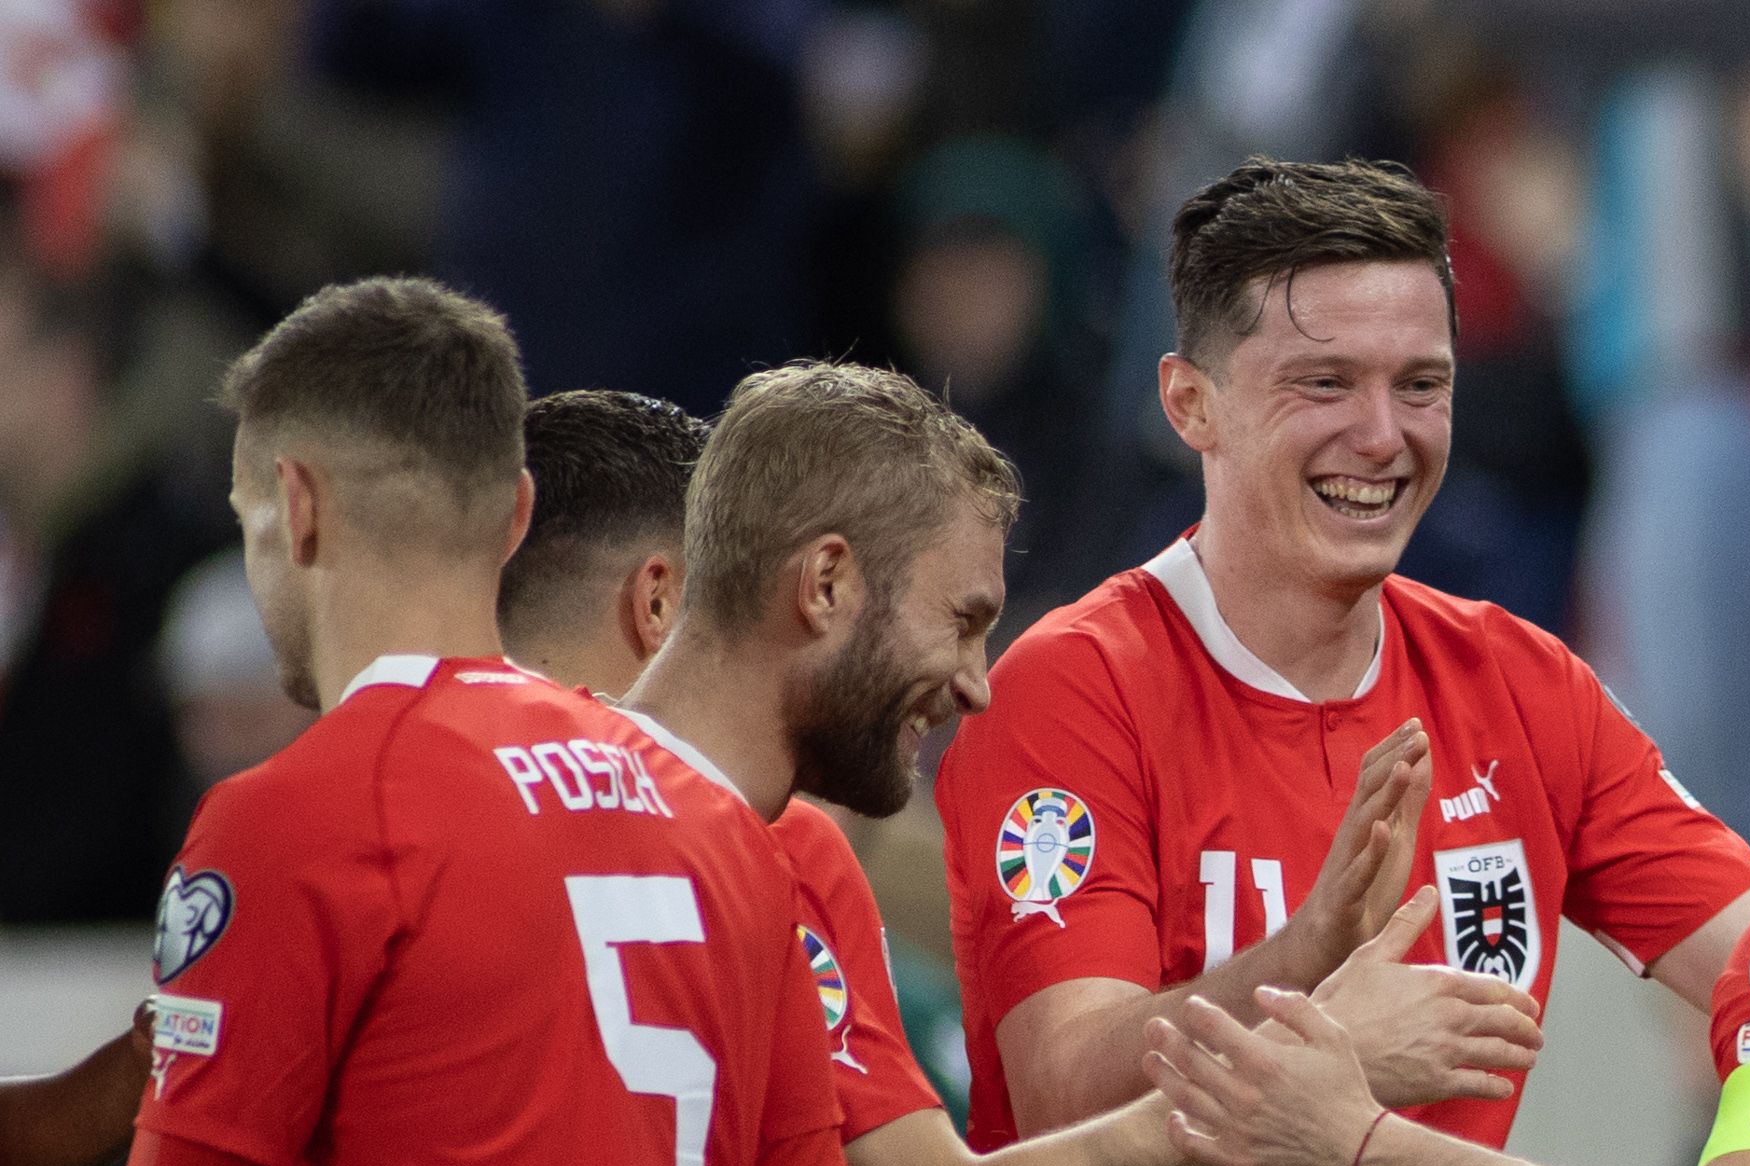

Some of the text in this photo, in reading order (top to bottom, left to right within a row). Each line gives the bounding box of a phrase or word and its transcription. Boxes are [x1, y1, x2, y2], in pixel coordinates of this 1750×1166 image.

[493, 739, 673, 818] POSCH
[1467, 855, 1505, 873] ÖFB
[1199, 850, 1289, 975] 11
